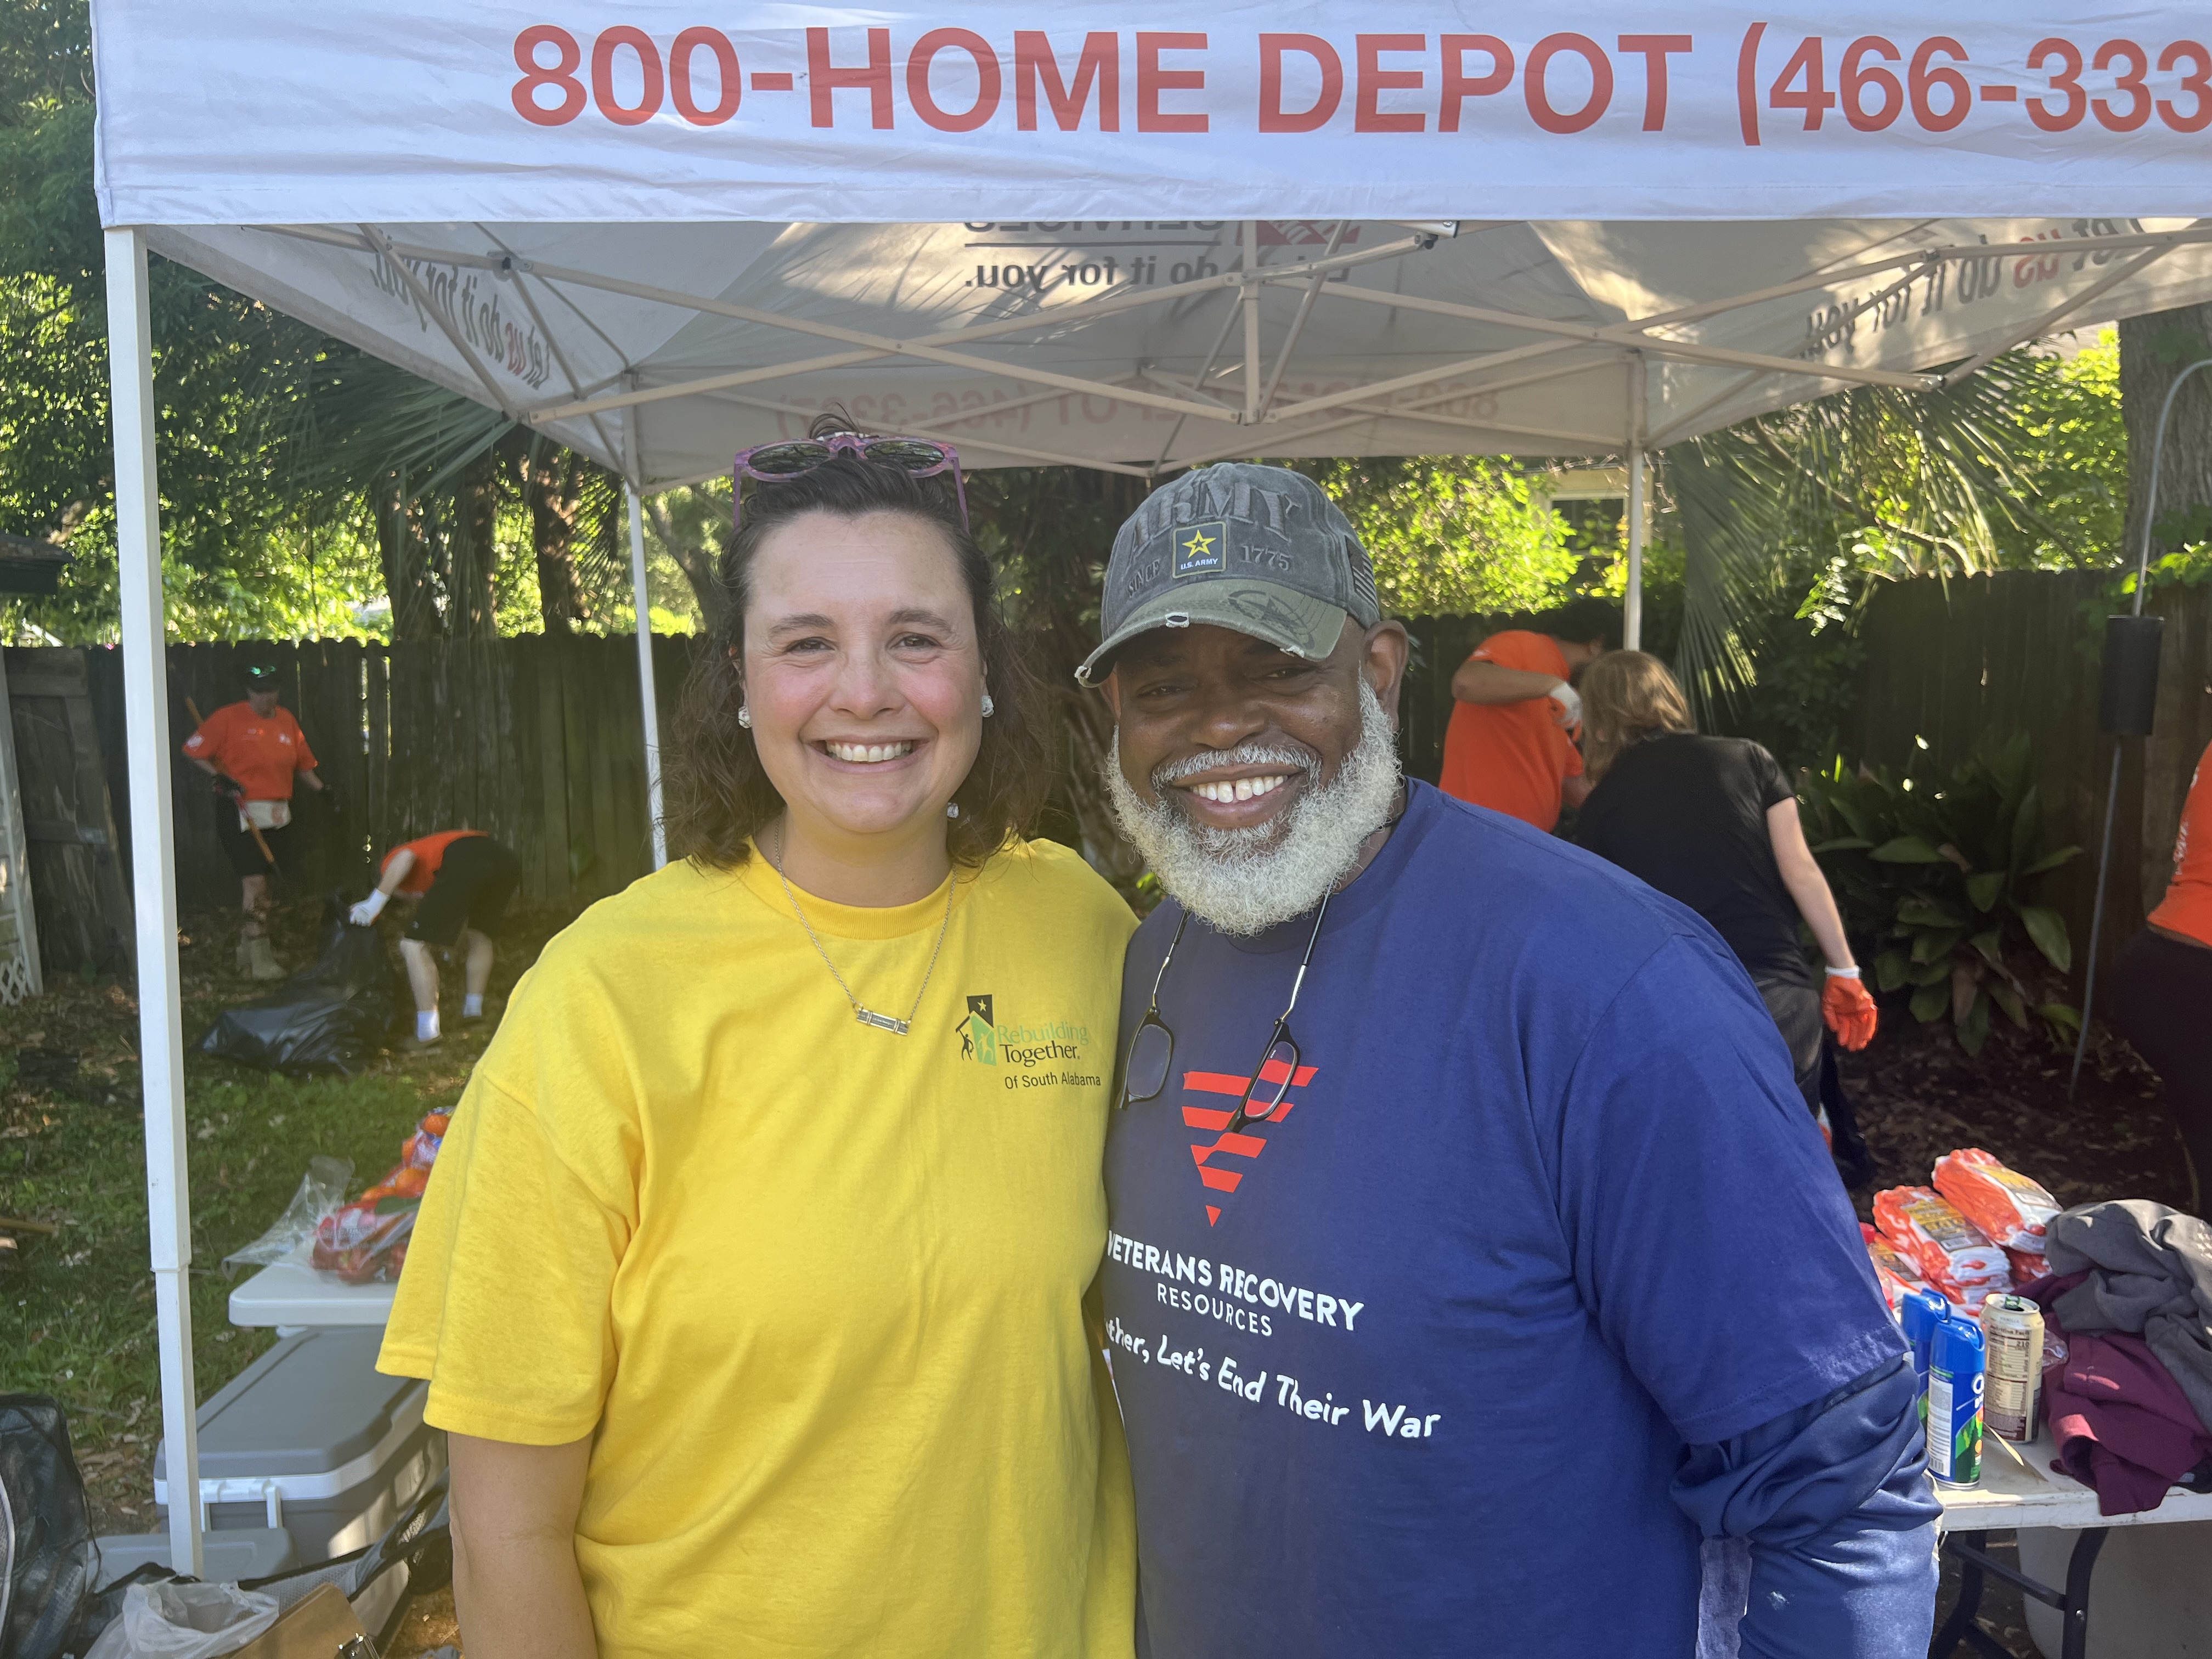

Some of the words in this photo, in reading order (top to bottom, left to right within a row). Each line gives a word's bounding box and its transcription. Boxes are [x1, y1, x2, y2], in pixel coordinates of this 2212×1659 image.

[512, 25, 1209, 133] 800-HOME
[1260, 32, 1692, 133] DEPOT
[1739, 22, 2212, 145] (466-333
[1129, 478, 1302, 563] ARMY
[1128, 558, 1161, 598] SINCE
[1181, 561, 1194, 570] U.S.
[1195, 558, 1218, 567] ARMY
[1239, 545, 1293, 571] 1775
[996, 1021, 1089, 1046] Rebuilding
[1005, 1075, 1018, 1089] Of
[1022, 1072, 1058, 1088] South
[1062, 1071, 1101, 1086] Alabama
[1107, 1229, 1212, 1286] VETERANS
[1219, 1263, 1364, 1331] RECOVERY
[1157, 1283, 1273, 1336] RESOURCES
[1157, 1334, 1211, 1381] Let's
[1218, 1357, 1267, 1402] End
[1277, 1374, 1349, 1425] Their
[1362, 1399, 1441, 1438] War
